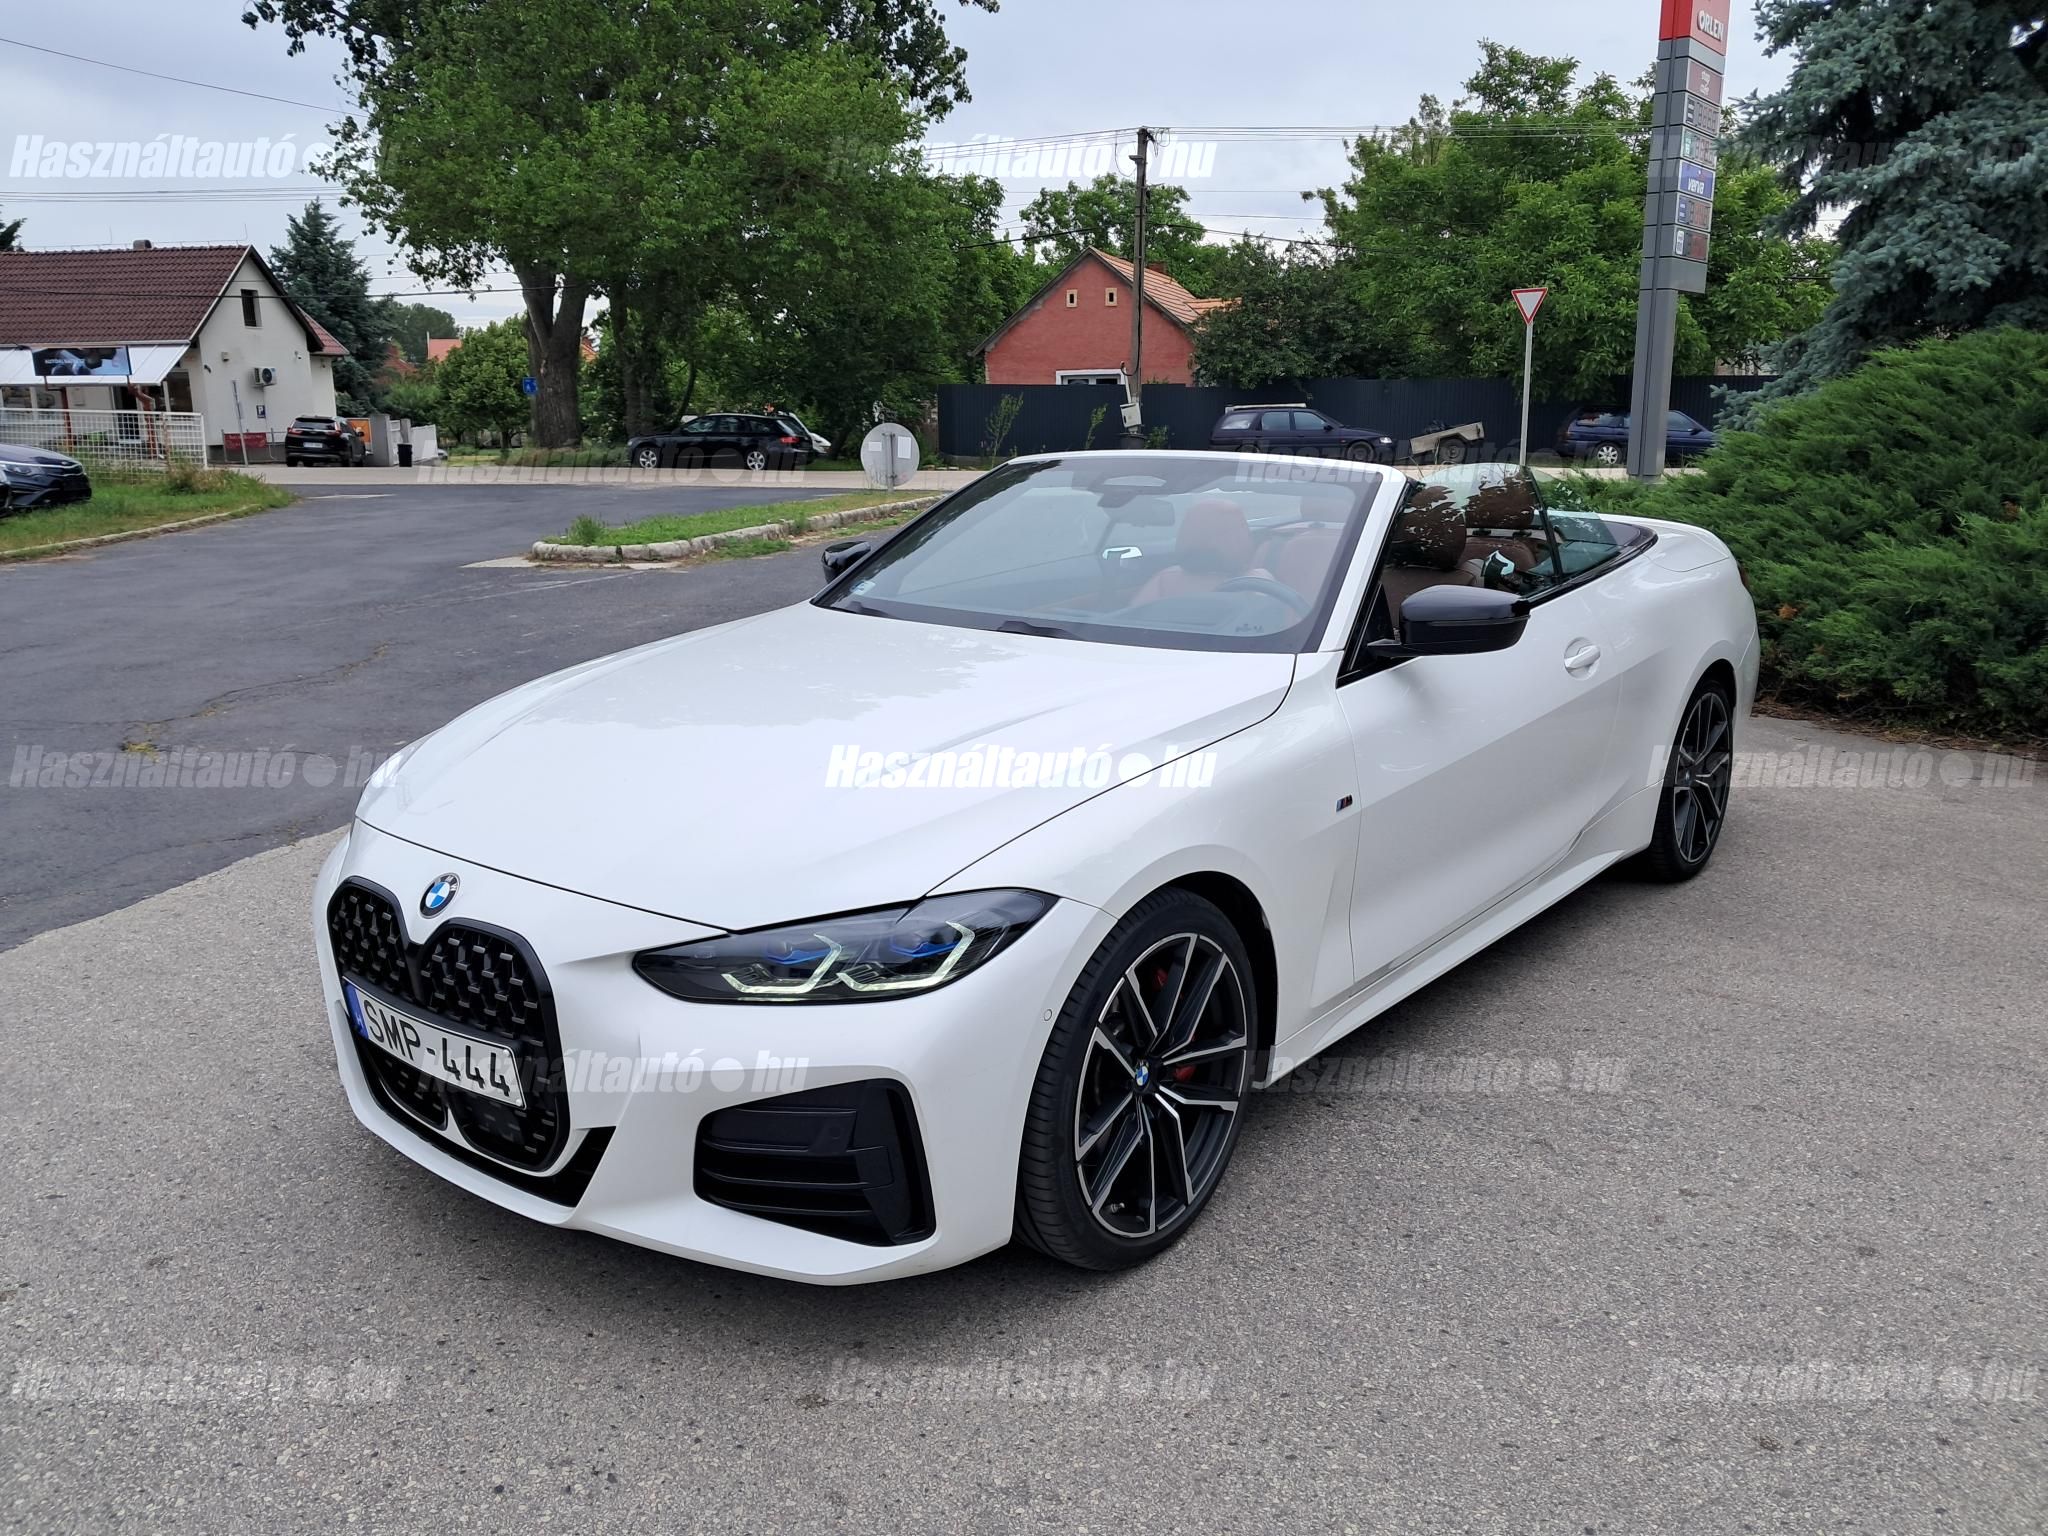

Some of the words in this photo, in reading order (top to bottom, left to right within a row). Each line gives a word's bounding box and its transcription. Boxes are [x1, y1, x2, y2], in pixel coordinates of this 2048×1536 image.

[1698, 9, 1724, 41] ORLEN
[1687, 177, 1705, 195] verva
[363, 999, 510, 1096] SMP-444
